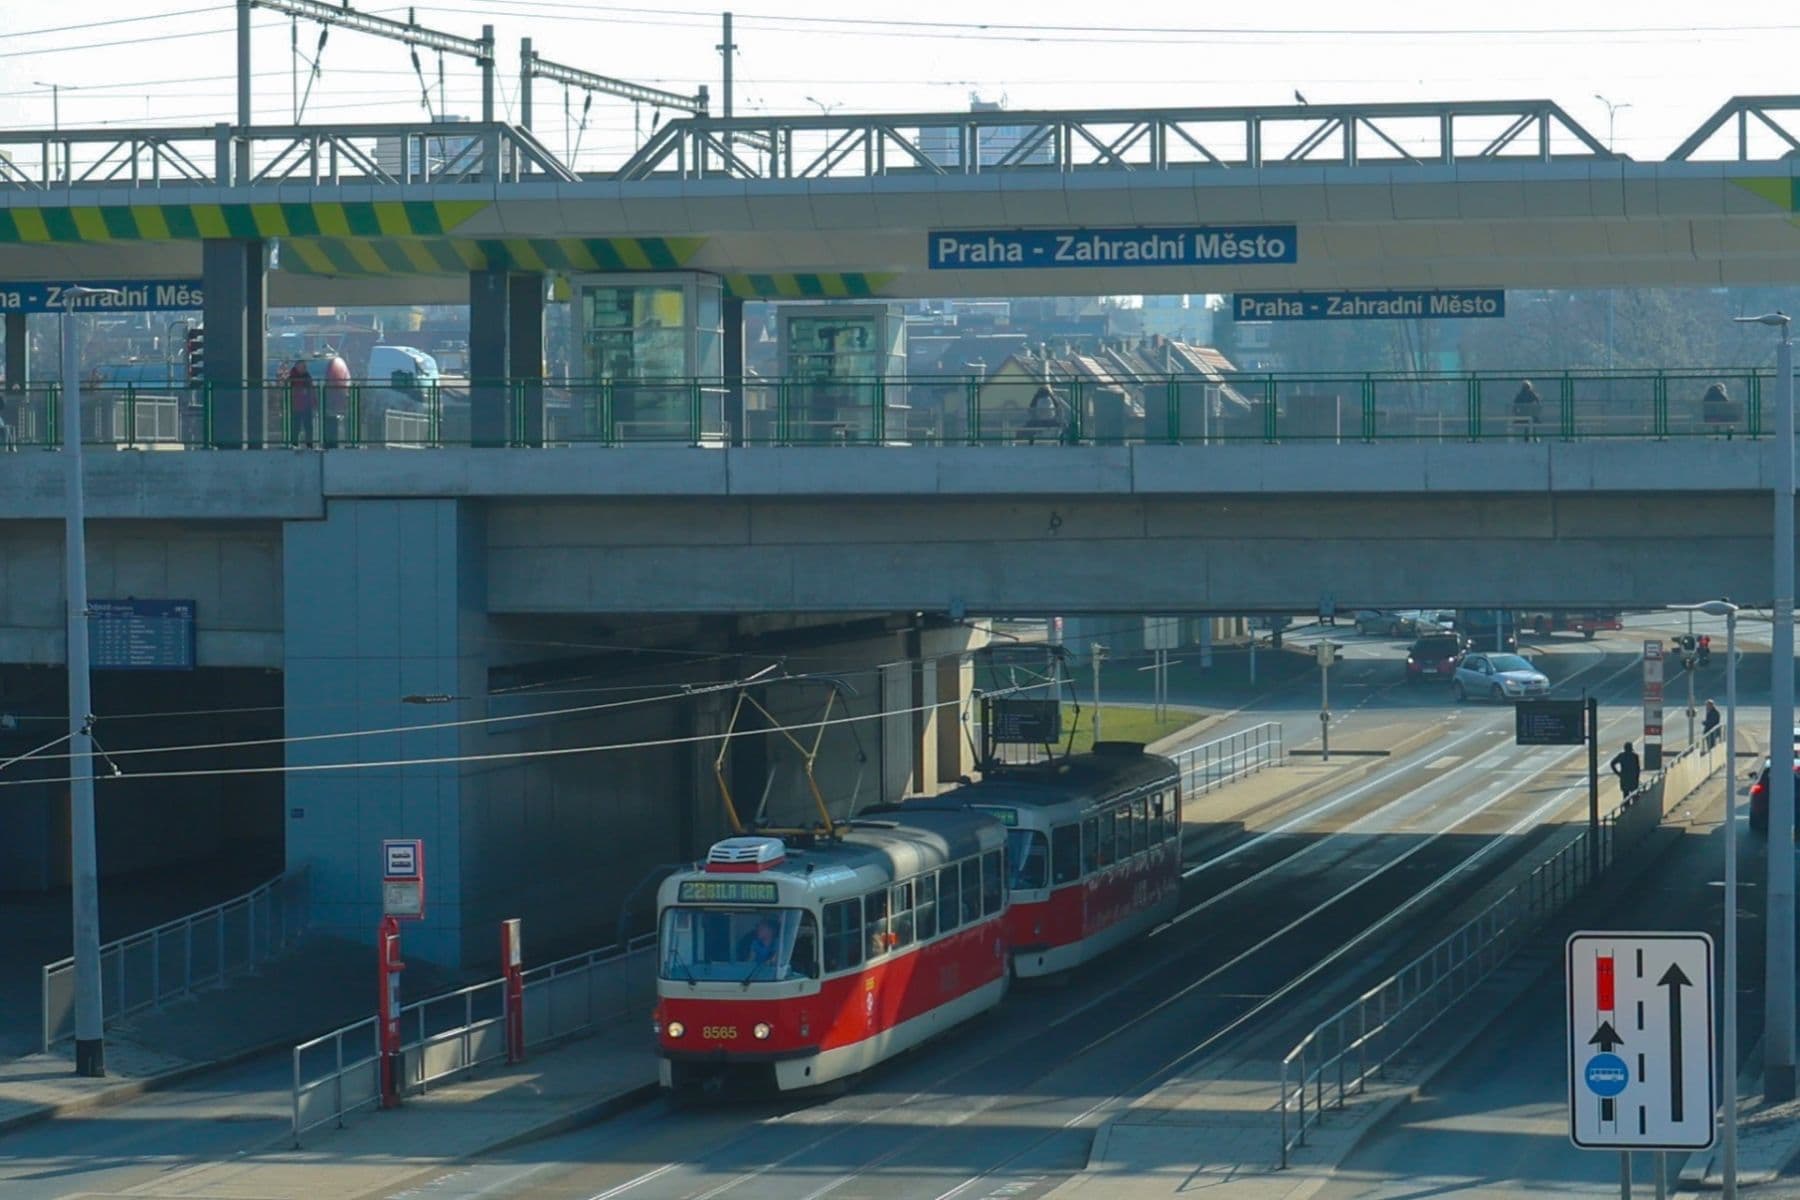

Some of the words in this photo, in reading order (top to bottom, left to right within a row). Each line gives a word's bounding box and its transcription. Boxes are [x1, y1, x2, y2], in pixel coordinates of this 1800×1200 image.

[938, 237, 1023, 263] Praha
[1055, 233, 1185, 261] Zahradní
[1194, 232, 1286, 259] Město
[1240, 297, 1304, 317] Praha
[1326, 296, 1423, 315] Zahradní
[1430, 294, 1497, 313] Město
[682, 882, 706, 900] 22
[703, 1025, 737, 1039] 8565
